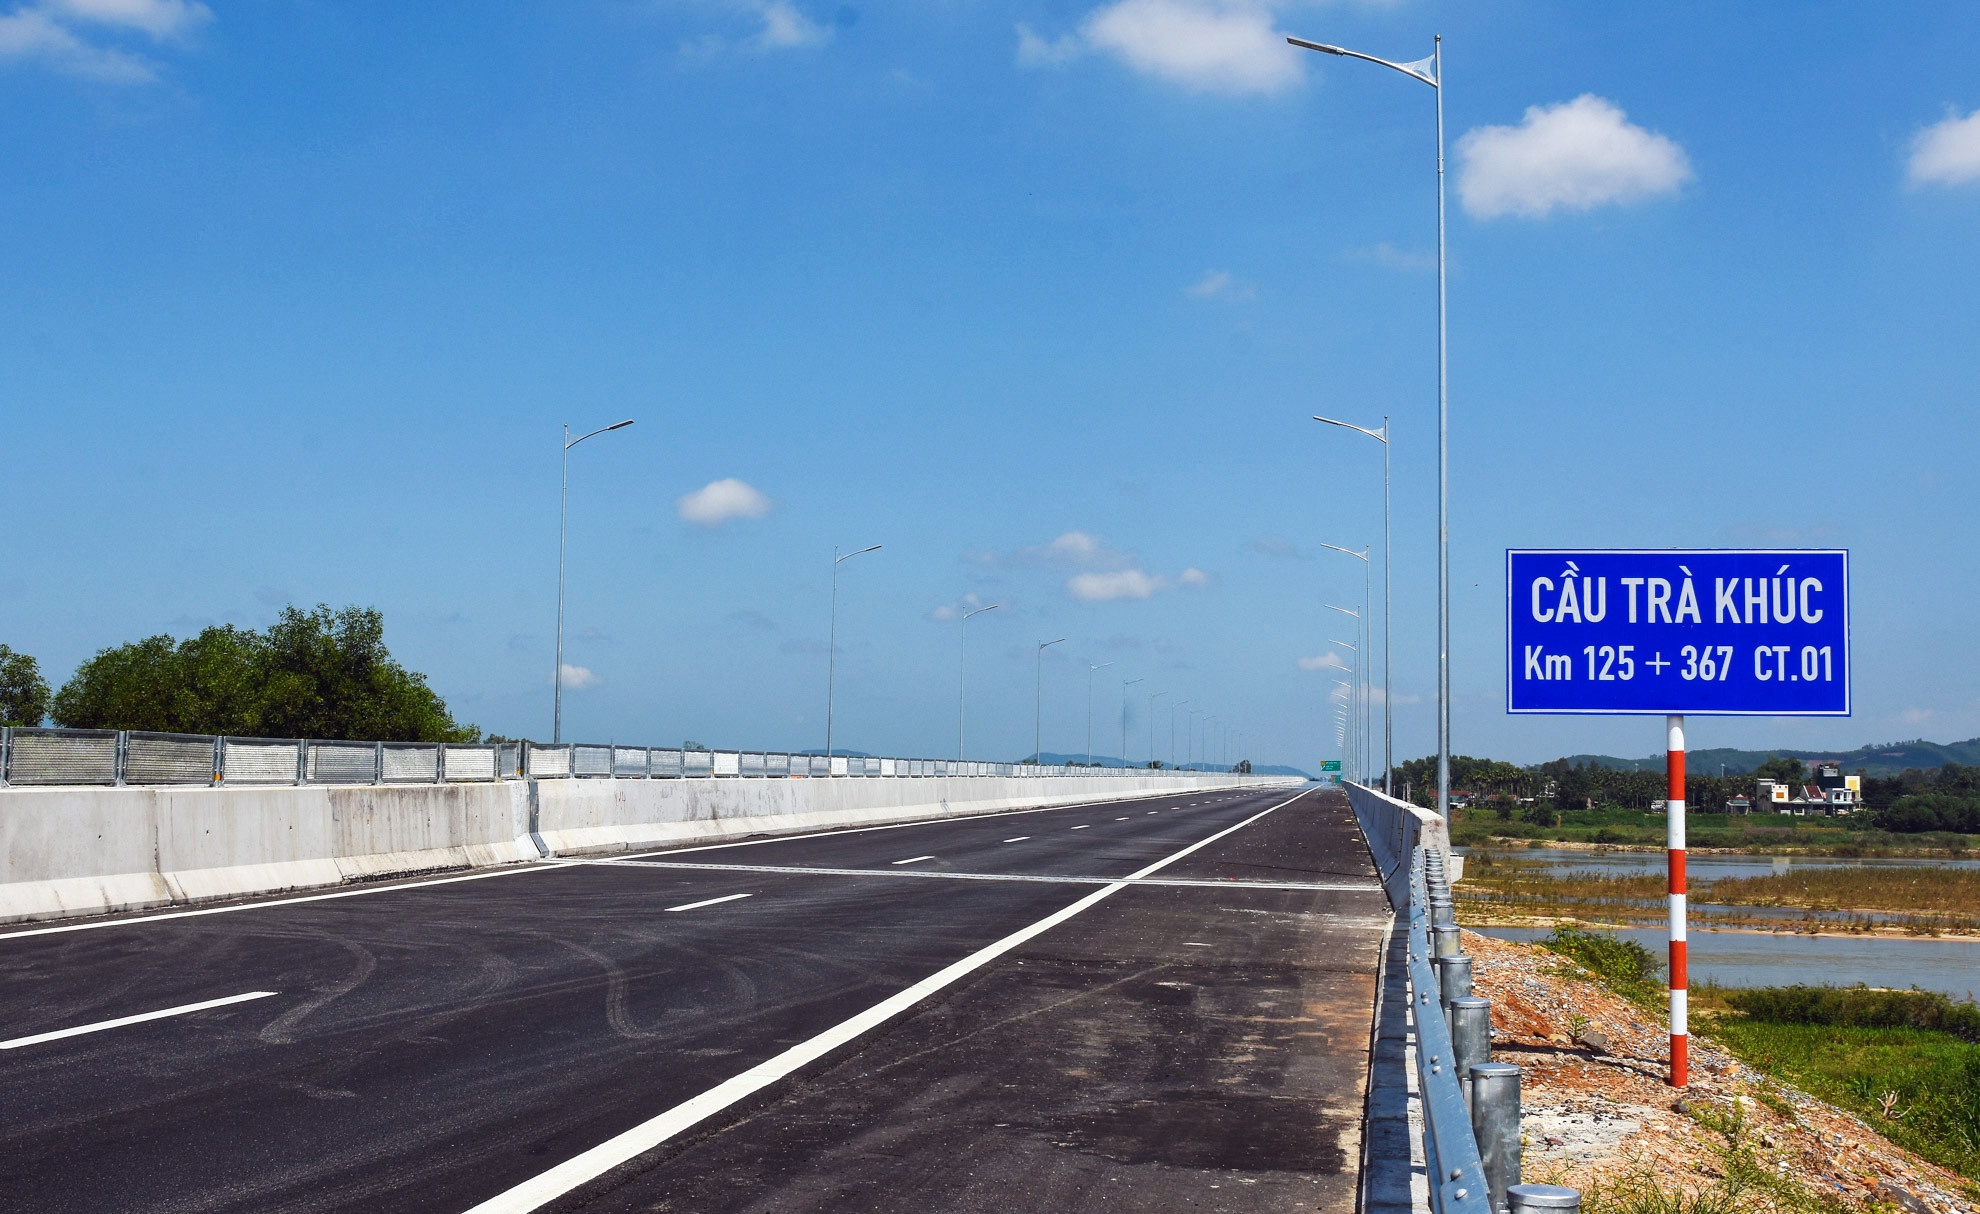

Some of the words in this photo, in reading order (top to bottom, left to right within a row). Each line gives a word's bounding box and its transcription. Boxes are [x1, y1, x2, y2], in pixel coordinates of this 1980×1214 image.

[1531, 560, 1606, 624] CẦU
[1620, 565, 1702, 624] TRÀ
[1715, 564, 1823, 624] KHÚC
[1525, 645, 1572, 681] Km
[1583, 645, 1635, 681] 125
[1645, 651, 1671, 676] +
[1680, 645, 1734, 681] 367
[1754, 645, 1832, 682] CT.01
